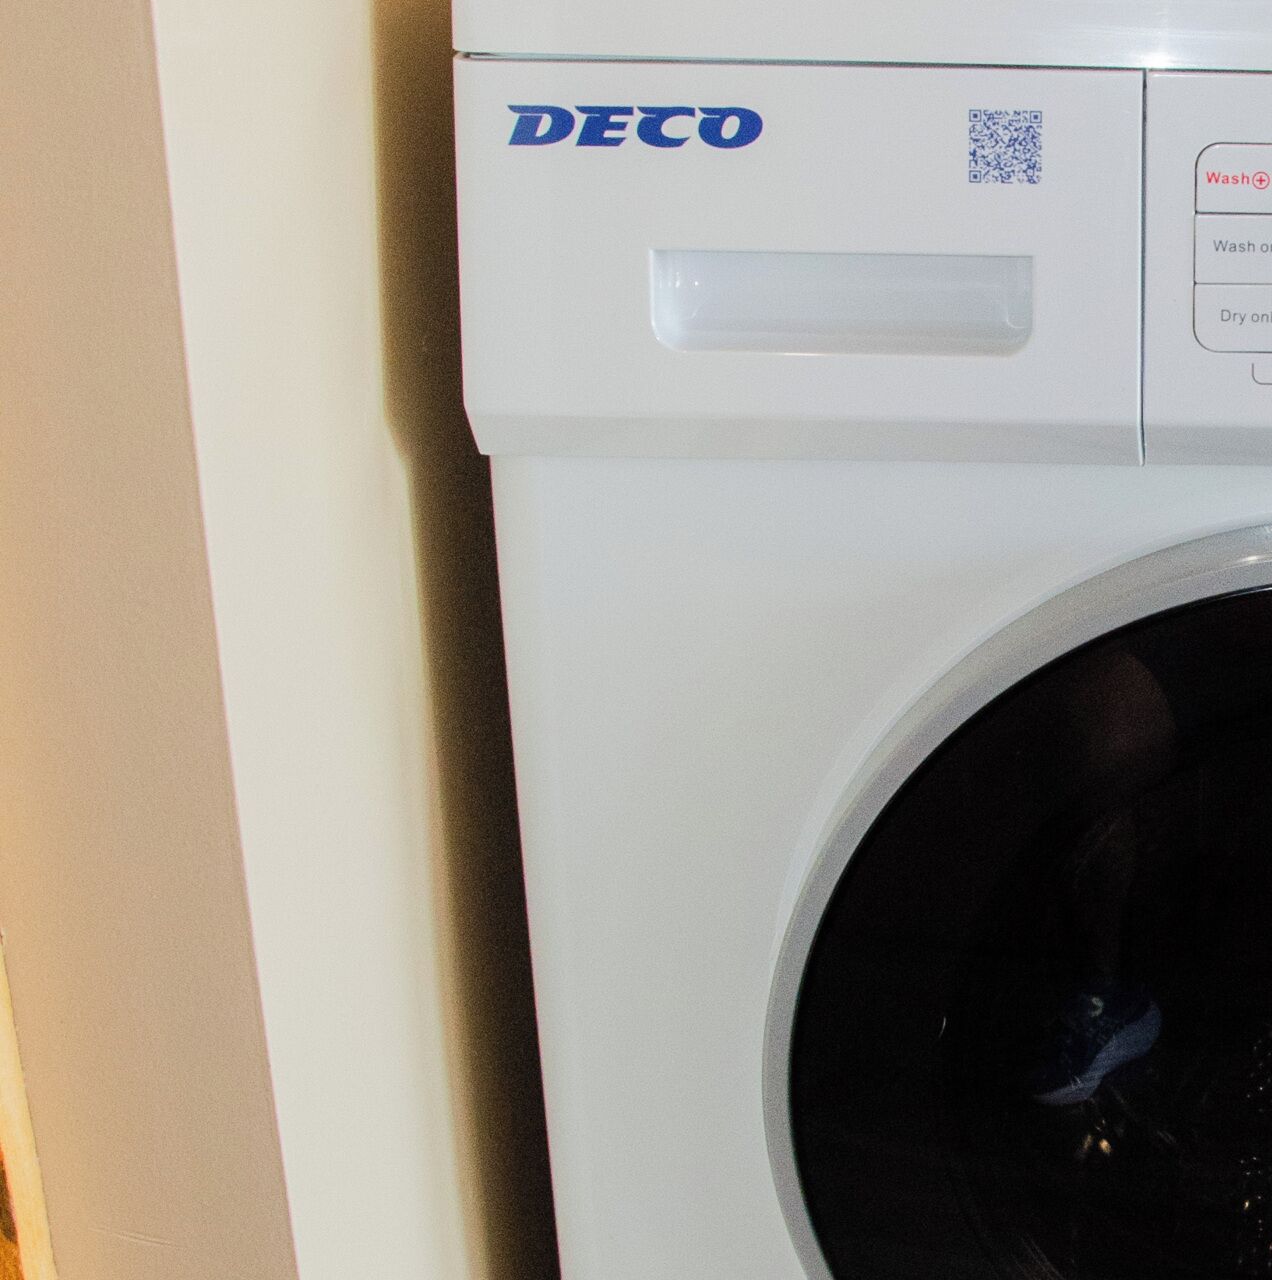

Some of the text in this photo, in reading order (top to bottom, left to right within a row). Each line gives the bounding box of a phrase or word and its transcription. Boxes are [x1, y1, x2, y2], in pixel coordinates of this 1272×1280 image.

[507, 104, 764, 150] DECO
[1212, 239, 1256, 253] Wash
[1220, 308, 1247, 326] Dry
